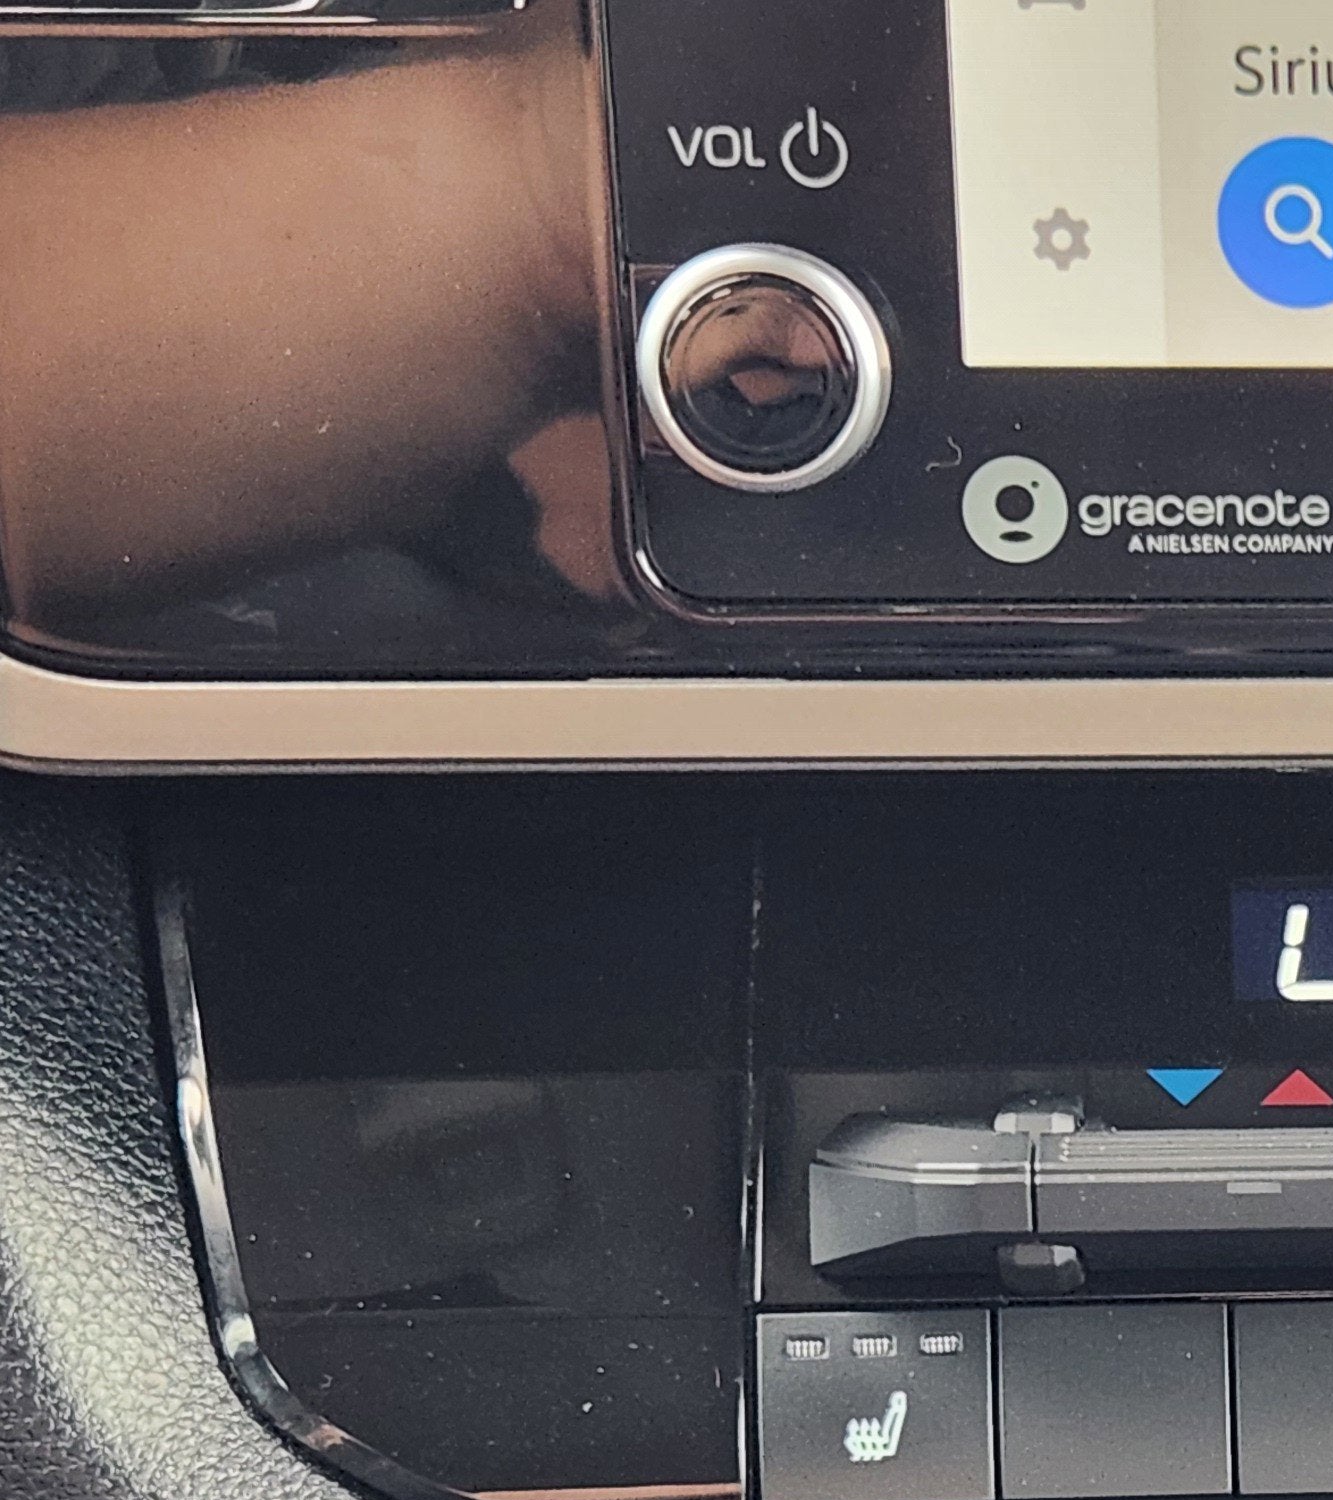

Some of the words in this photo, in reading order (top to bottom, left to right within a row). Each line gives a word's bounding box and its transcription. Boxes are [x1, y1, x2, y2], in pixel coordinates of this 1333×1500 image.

[667, 124, 766, 168] VOL
[1077, 488, 1331, 536] gracenote
[1127, 534, 1145, 553] A
[1146, 533, 1230, 554] NIELSEN
